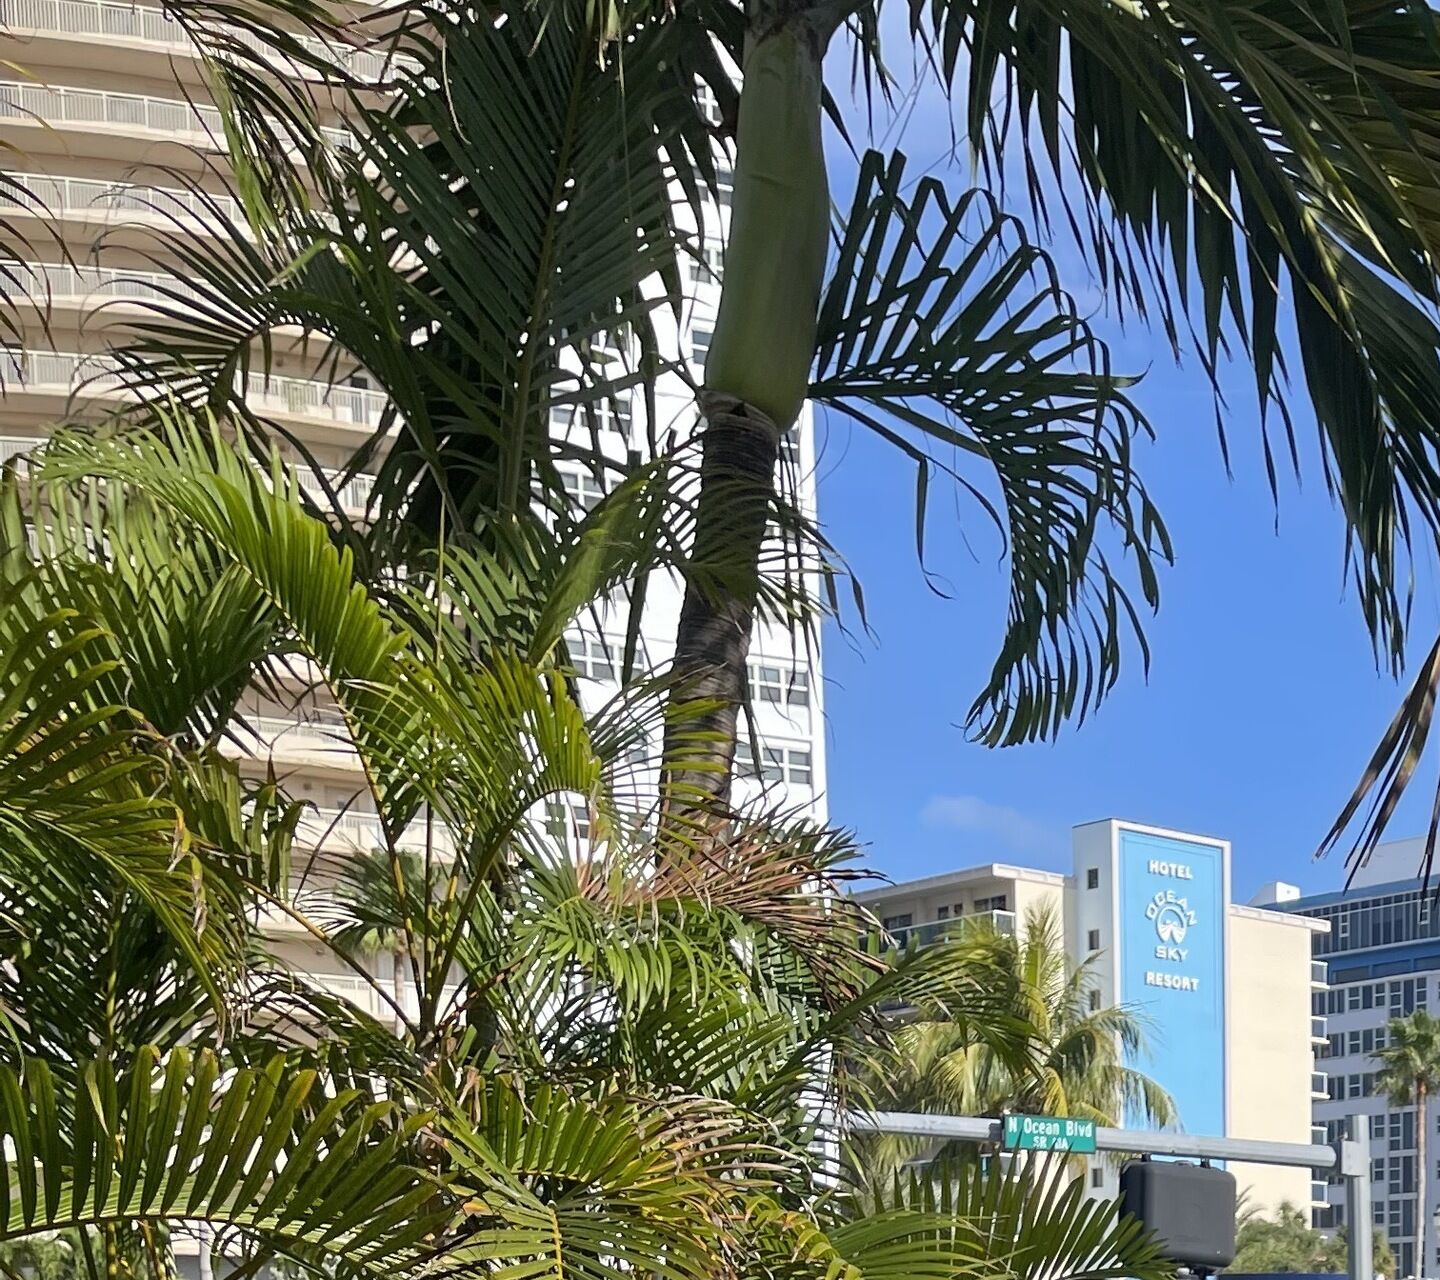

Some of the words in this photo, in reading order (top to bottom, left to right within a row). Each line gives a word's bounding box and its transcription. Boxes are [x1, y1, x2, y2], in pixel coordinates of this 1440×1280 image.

[1148, 860, 1193, 880] HOTEL
[1145, 890, 1197, 926] OCEAN
[1155, 945, 1188, 962] SKY
[1145, 971, 1200, 991] RESORT
[1008, 1117, 1018, 1132] N
[1024, 1117, 1060, 1135] Ocean
[1066, 1120, 1093, 1137] Blvd
[1033, 1136, 1047, 1148] SR
